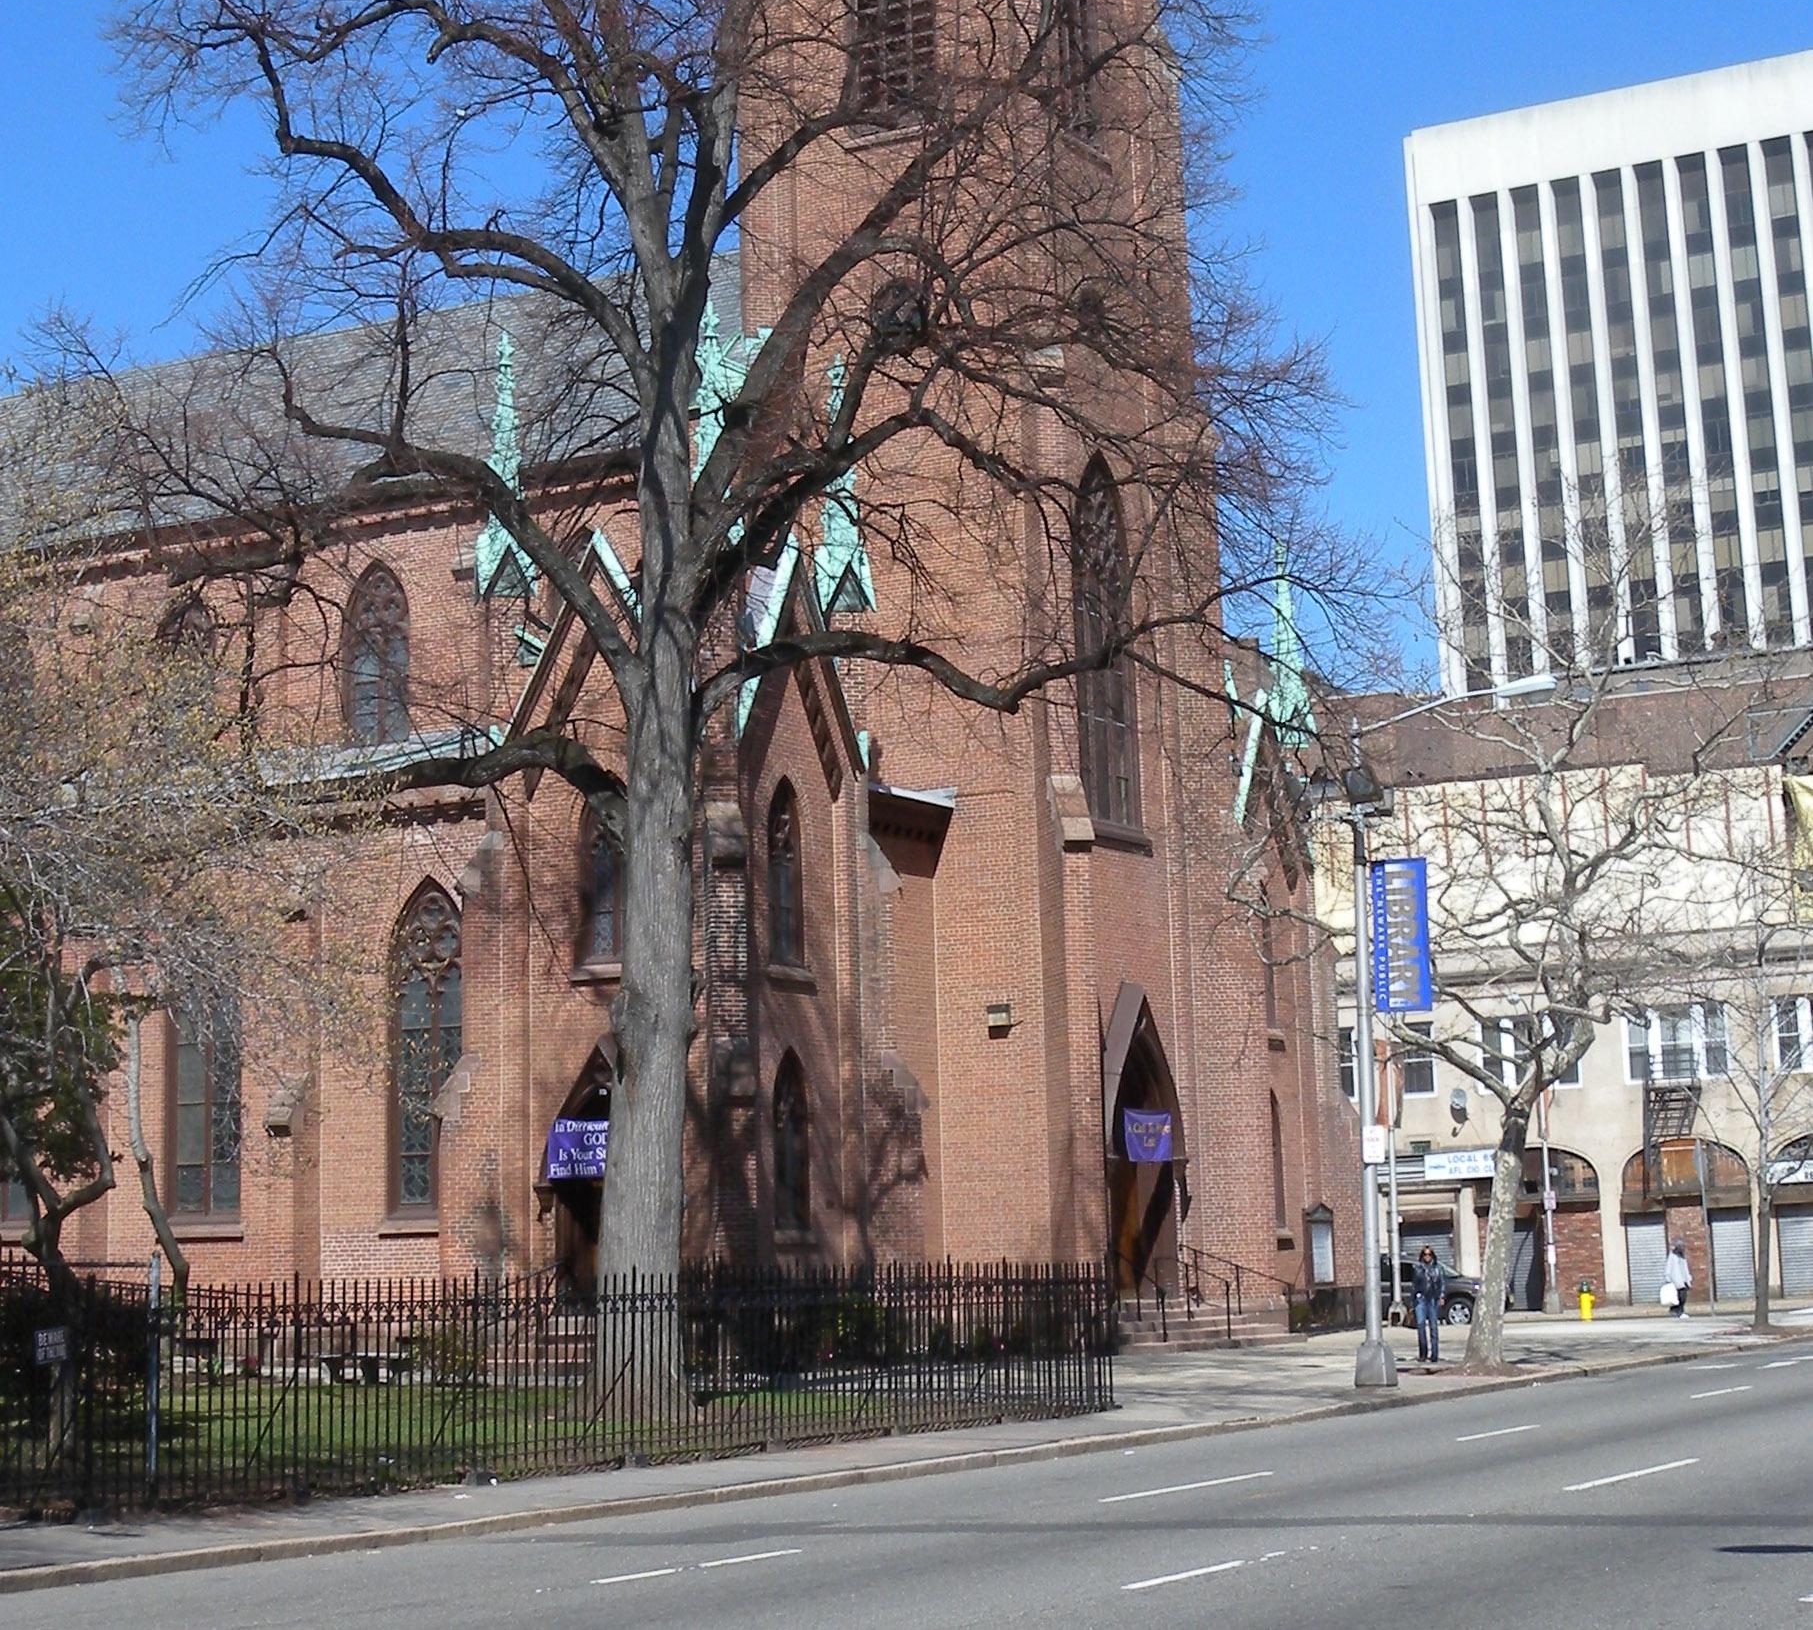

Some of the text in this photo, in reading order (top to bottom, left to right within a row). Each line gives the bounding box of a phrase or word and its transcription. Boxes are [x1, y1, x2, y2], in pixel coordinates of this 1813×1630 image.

[1377, 900, 1386, 949] NEWARK
[1385, 870, 1420, 1003] LIBRARY
[1378, 956, 1387, 1000] PUBLIC
[555, 1121, 565, 1133] In
[559, 1148, 568, 1161] Is
[570, 1147, 594, 1160] Your
[1447, 1153, 1478, 1164] LOCAL
[550, 1163, 571, 1176] Find
[574, 1162, 597, 1175] Him
